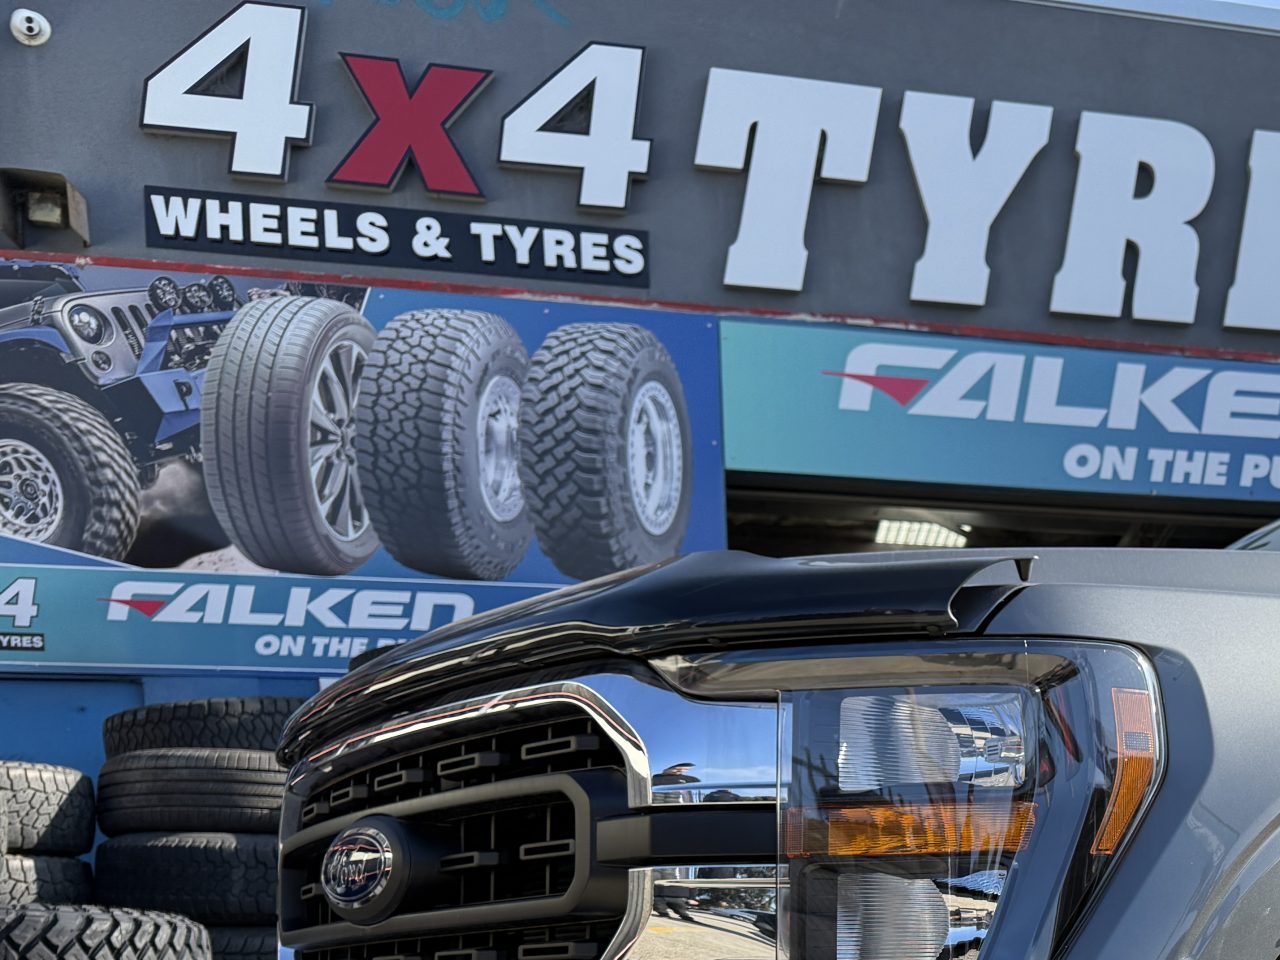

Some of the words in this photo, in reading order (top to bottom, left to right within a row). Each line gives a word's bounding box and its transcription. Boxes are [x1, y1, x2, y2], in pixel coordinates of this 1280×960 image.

[151, 195, 390, 253] WHEELS
[412, 217, 451, 257] &
[470, 222, 645, 275] TYRES
[1063, 444, 1138, 481] ON
[1147, 448, 1231, 486] THE
[107, 581, 474, 631] FALKEN
[0, 635, 44, 648] YRES
[255, 634, 305, 656] ON
[312, 636, 368, 658] THE
